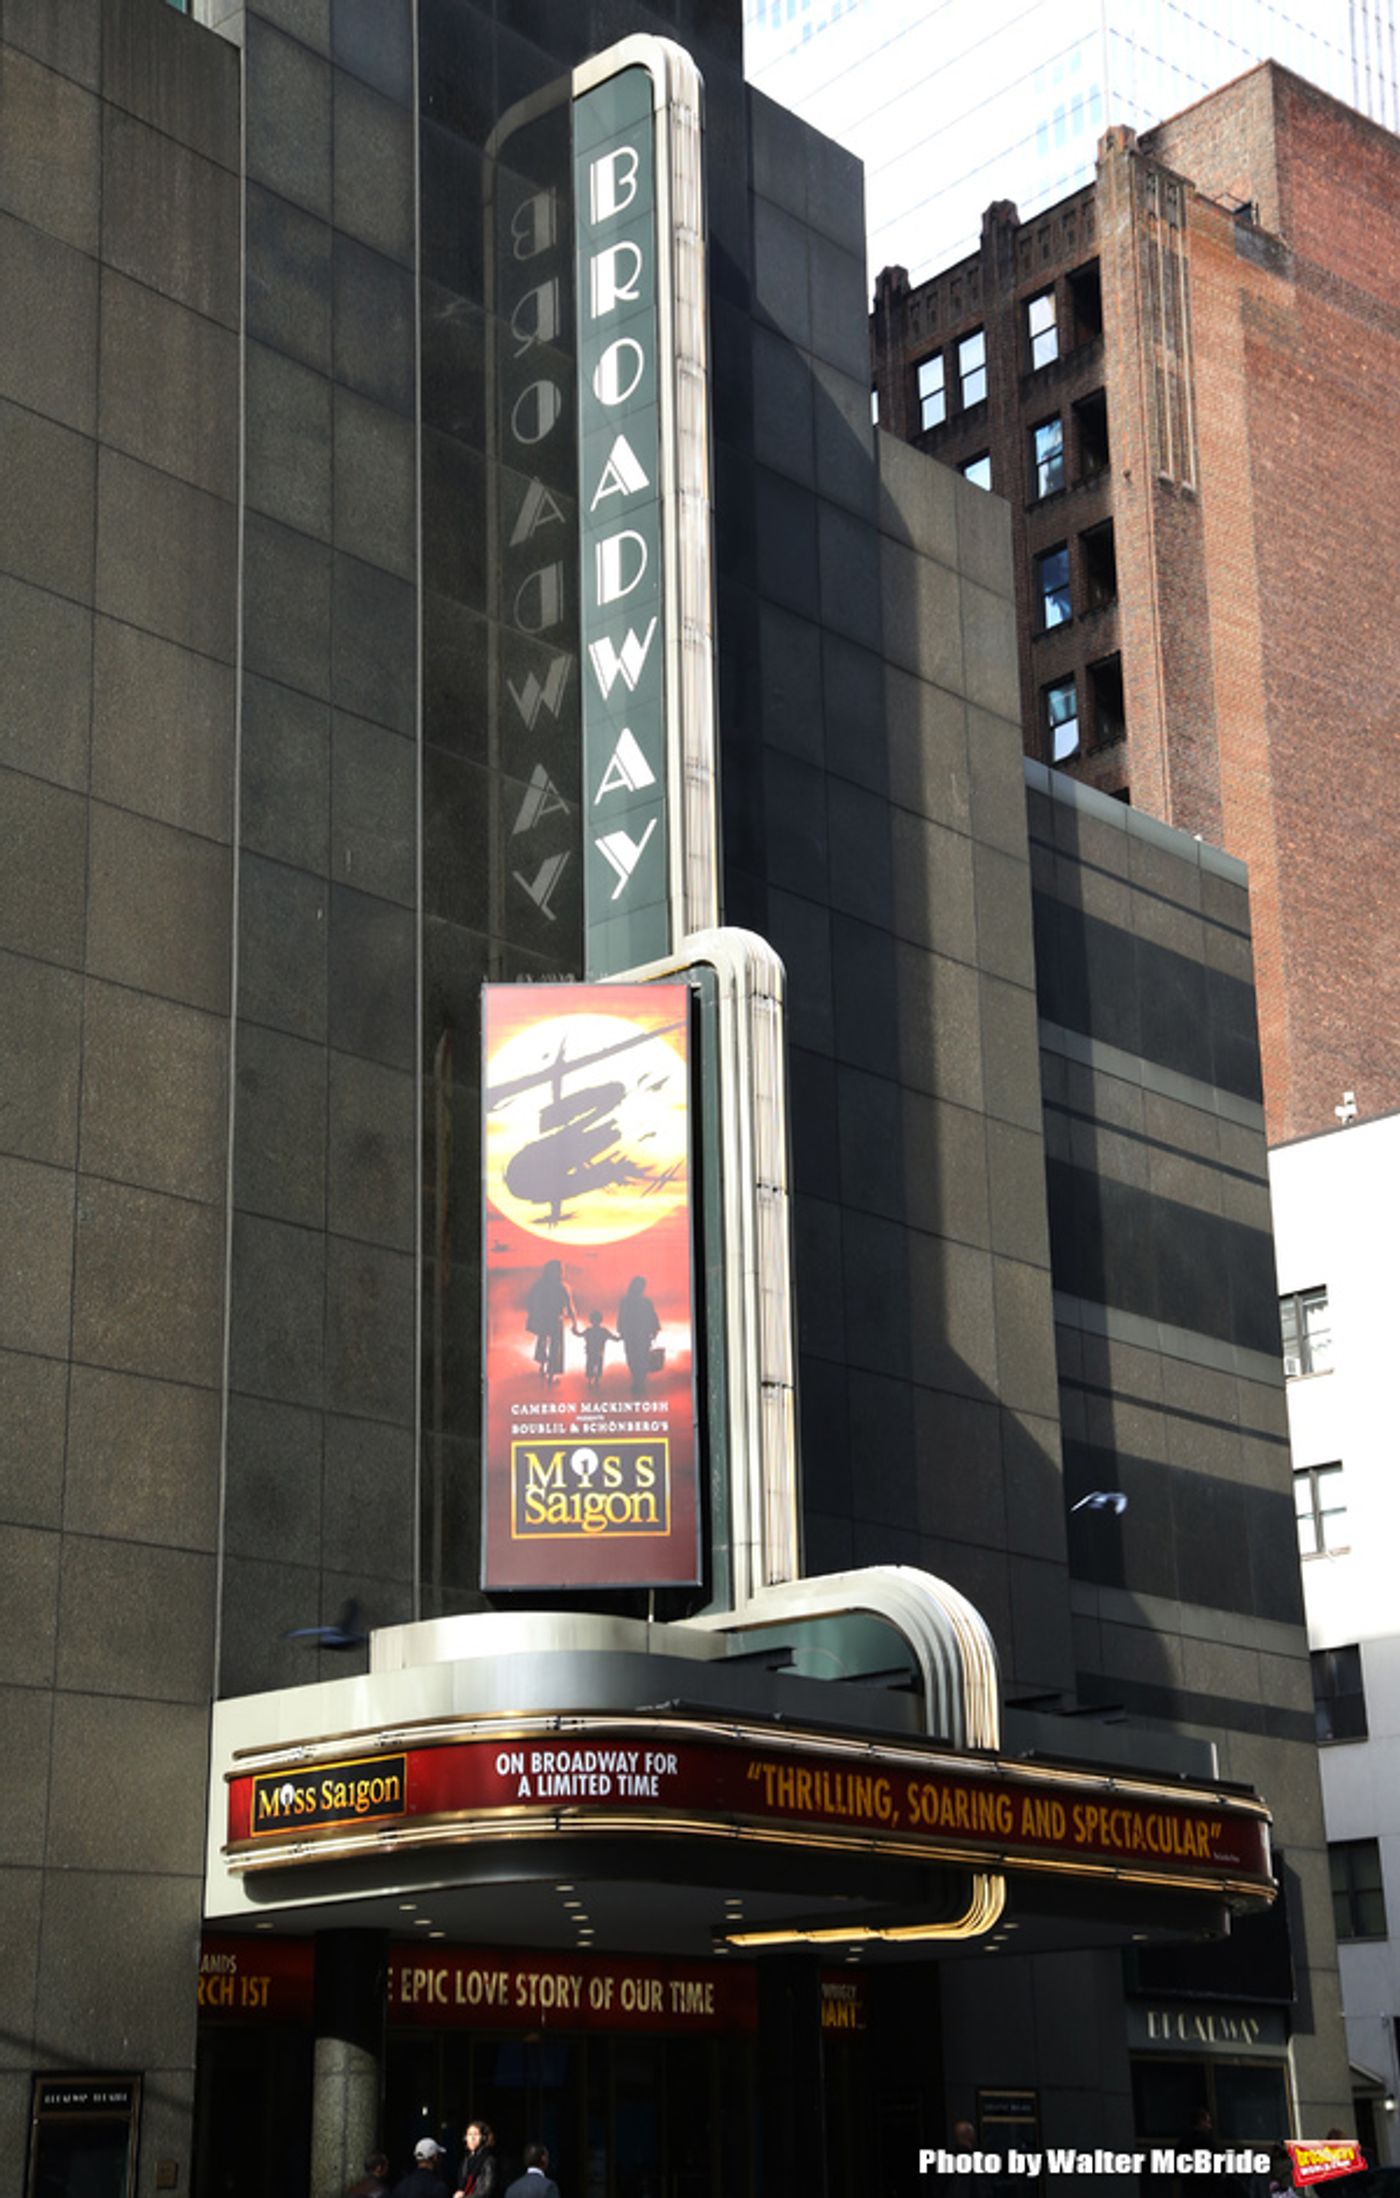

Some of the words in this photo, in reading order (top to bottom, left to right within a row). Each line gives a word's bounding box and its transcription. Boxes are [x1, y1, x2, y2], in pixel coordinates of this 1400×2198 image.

[589, 144, 658, 900] BROADWAY
[510, 1402, 577, 1416] CAMERON
[580, 1401, 669, 1414] MACKINTOSH
[511, 1422, 566, 1435] BOUBLIL
[569, 1422, 579, 1433] &
[524, 1487, 660, 1532] Saigon
[495, 1752, 525, 1775] ON
[530, 1750, 638, 1774] BROADWAY
[645, 1752, 678, 1774] FOR
[258, 1782, 317, 1820] Miss
[320, 1774, 400, 1814] Saigon
[517, 1774, 531, 1797] A
[537, 1774, 612, 1797] LIMITED
[617, 1775, 659, 1796] TIME
[907, 1782, 1013, 1835] SOARING
[1020, 1798, 1066, 1842] AND
[200, 1953, 237, 1974] ANDS
[198, 1974, 235, 2007] RCH
[241, 1975, 271, 2008] 1ST
[401, 1968, 449, 2004] EPIC
[455, 1970, 509, 2006] LOVE
[515, 1972, 583, 2009] STORY
[589, 1977, 615, 2011] OF
[620, 1979, 664, 2013] OUR
[669, 1980, 716, 2016] TIME
